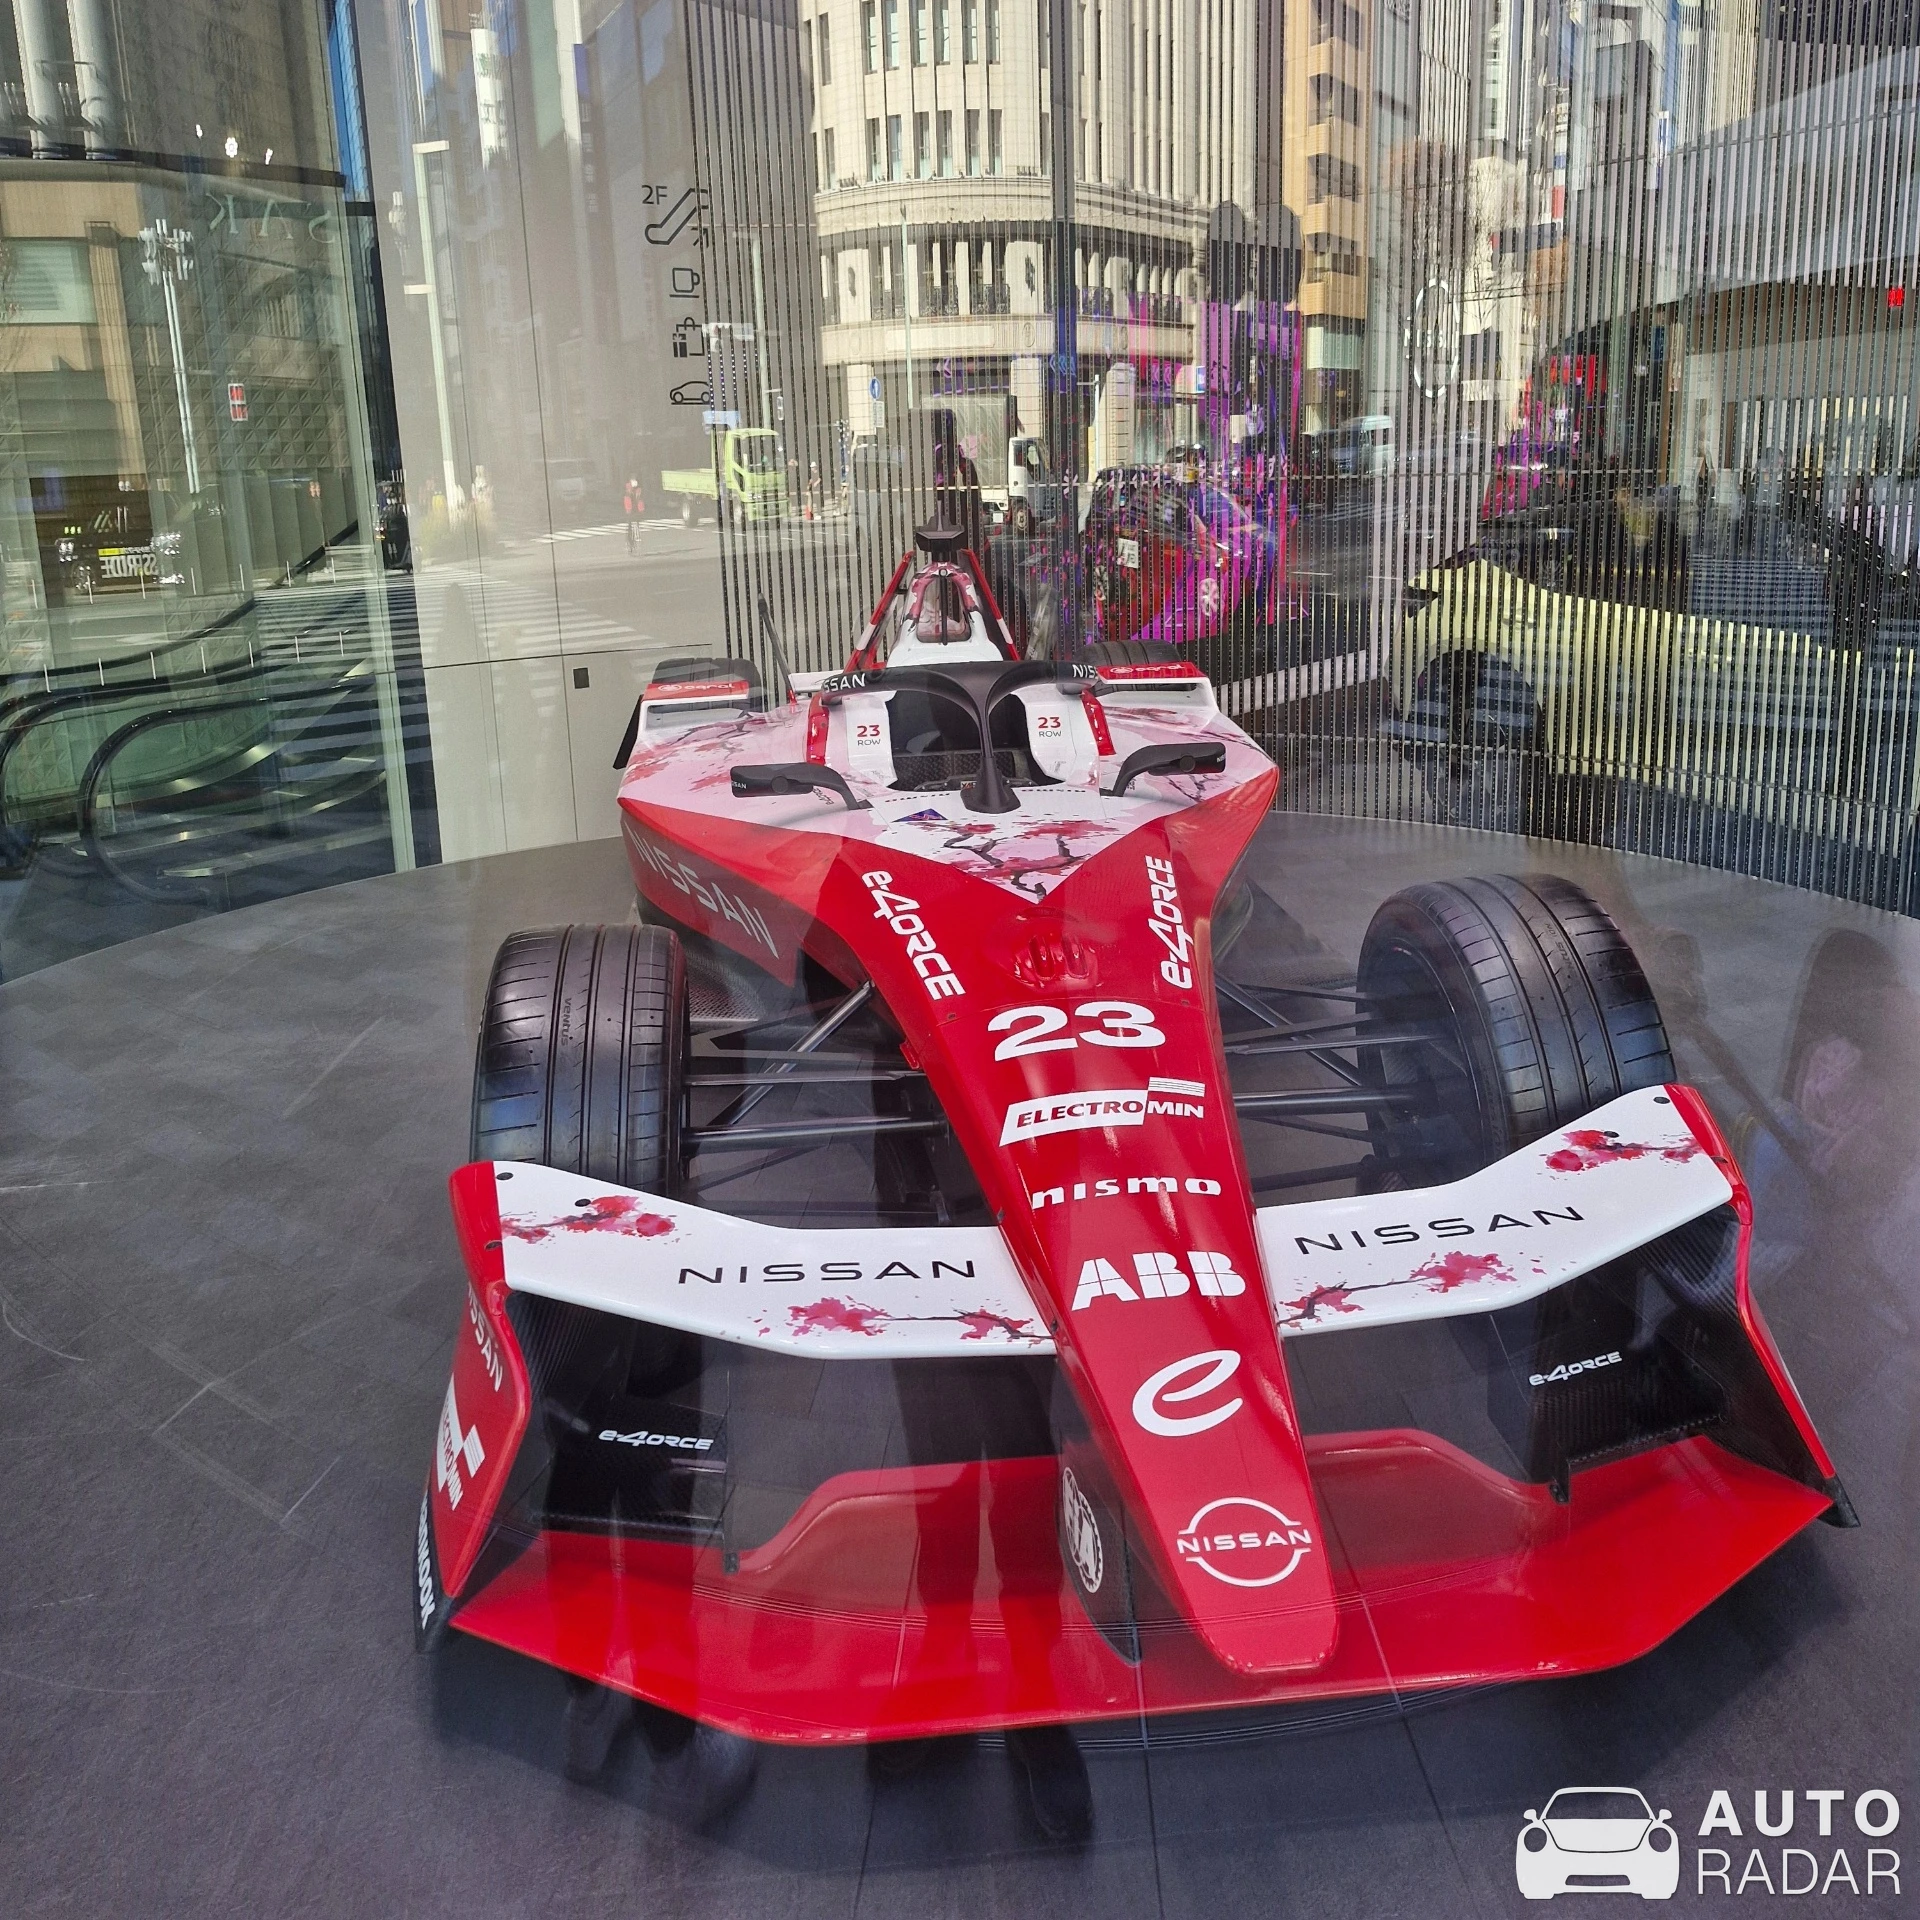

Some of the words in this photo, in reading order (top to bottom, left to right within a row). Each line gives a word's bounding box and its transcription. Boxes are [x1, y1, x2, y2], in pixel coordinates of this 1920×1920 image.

[641, 185, 668, 205] 2F
[857, 724, 881, 738] 23
[1038, 716, 1061, 729] 23
[1038, 730, 1062, 738] ROW
[624, 820, 780, 960] NISSAN
[987, 1001, 1166, 1062] 23
[1016, 1099, 1205, 1129] ELECTROMIN
[1032, 1177, 1222, 1210] nismo
[1294, 1206, 1585, 1255] NISSAN
[678, 1260, 976, 1284] NISSAN
[1071, 1251, 1246, 1311] ABB
[1176, 1529, 1312, 1554] NISSAN
